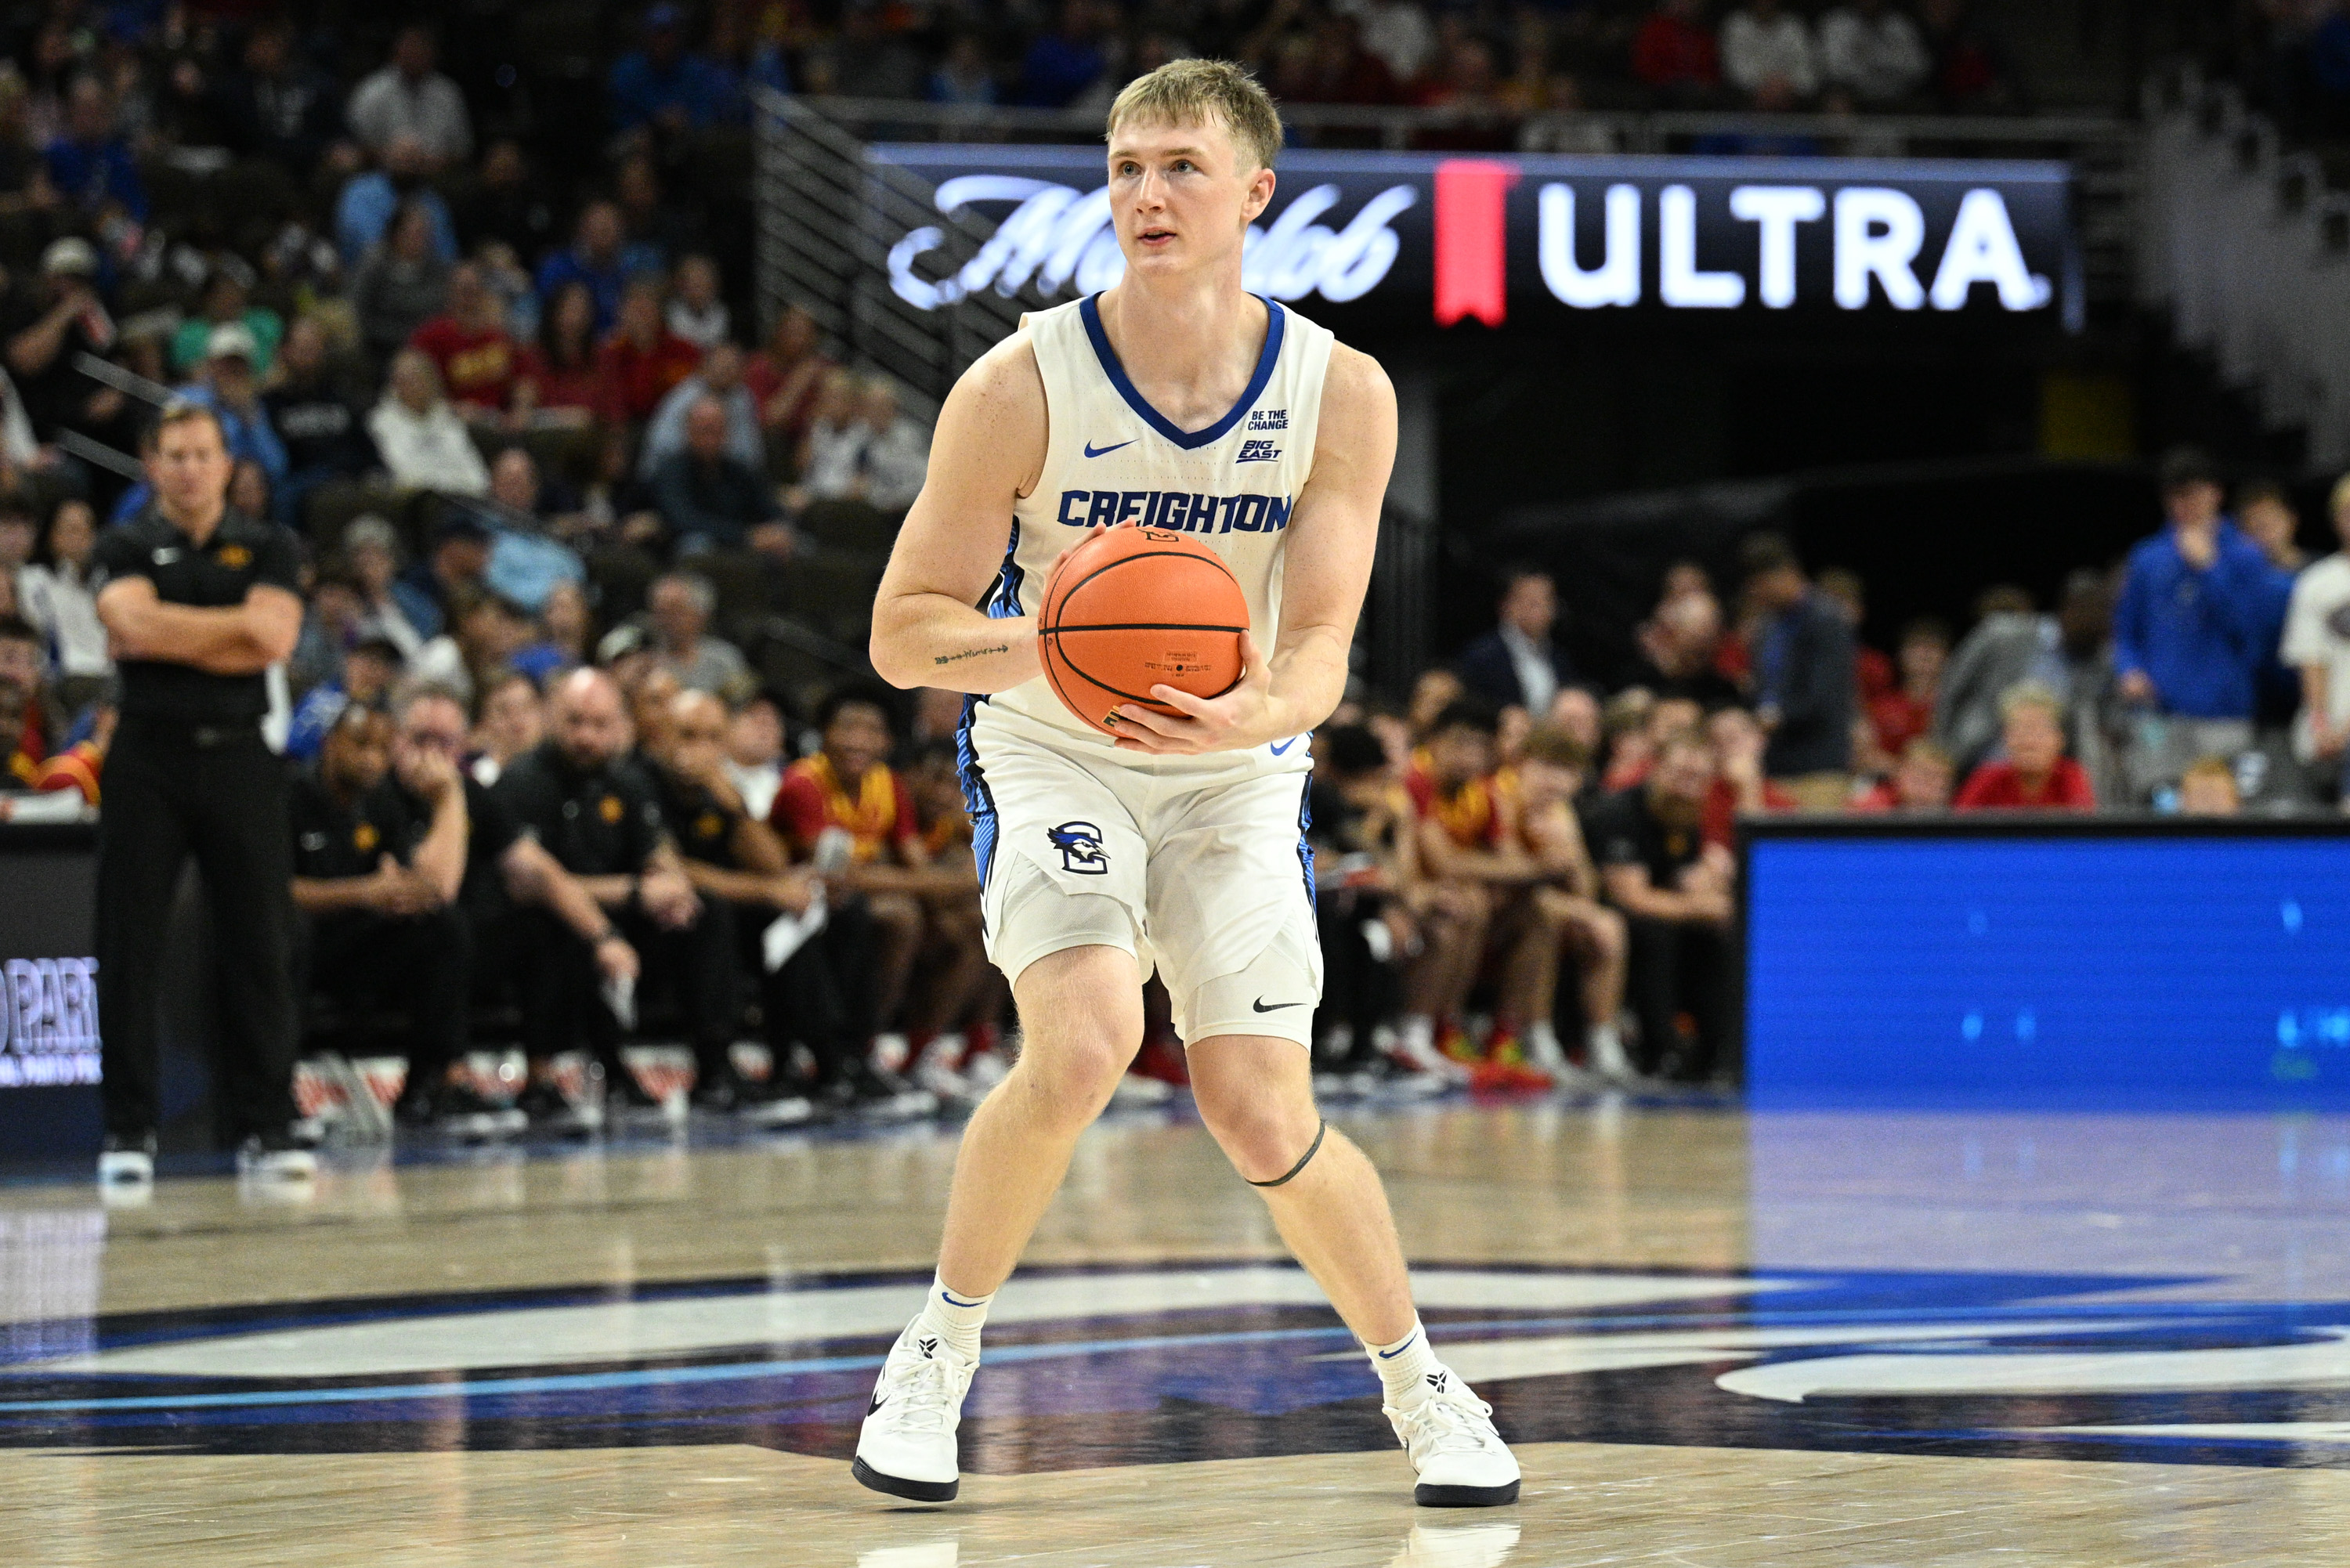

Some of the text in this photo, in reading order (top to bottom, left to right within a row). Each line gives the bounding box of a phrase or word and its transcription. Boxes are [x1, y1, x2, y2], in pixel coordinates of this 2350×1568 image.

[1538, 182, 2043, 311] ULTRA
[1252, 409, 1287, 420] BE THE
[1248, 419, 1289, 431] CHANGE
[1242, 439, 1274, 450] BIG
[1238, 449, 1282, 458] EAST
[1057, 490, 1292, 534] CREIGHTON
